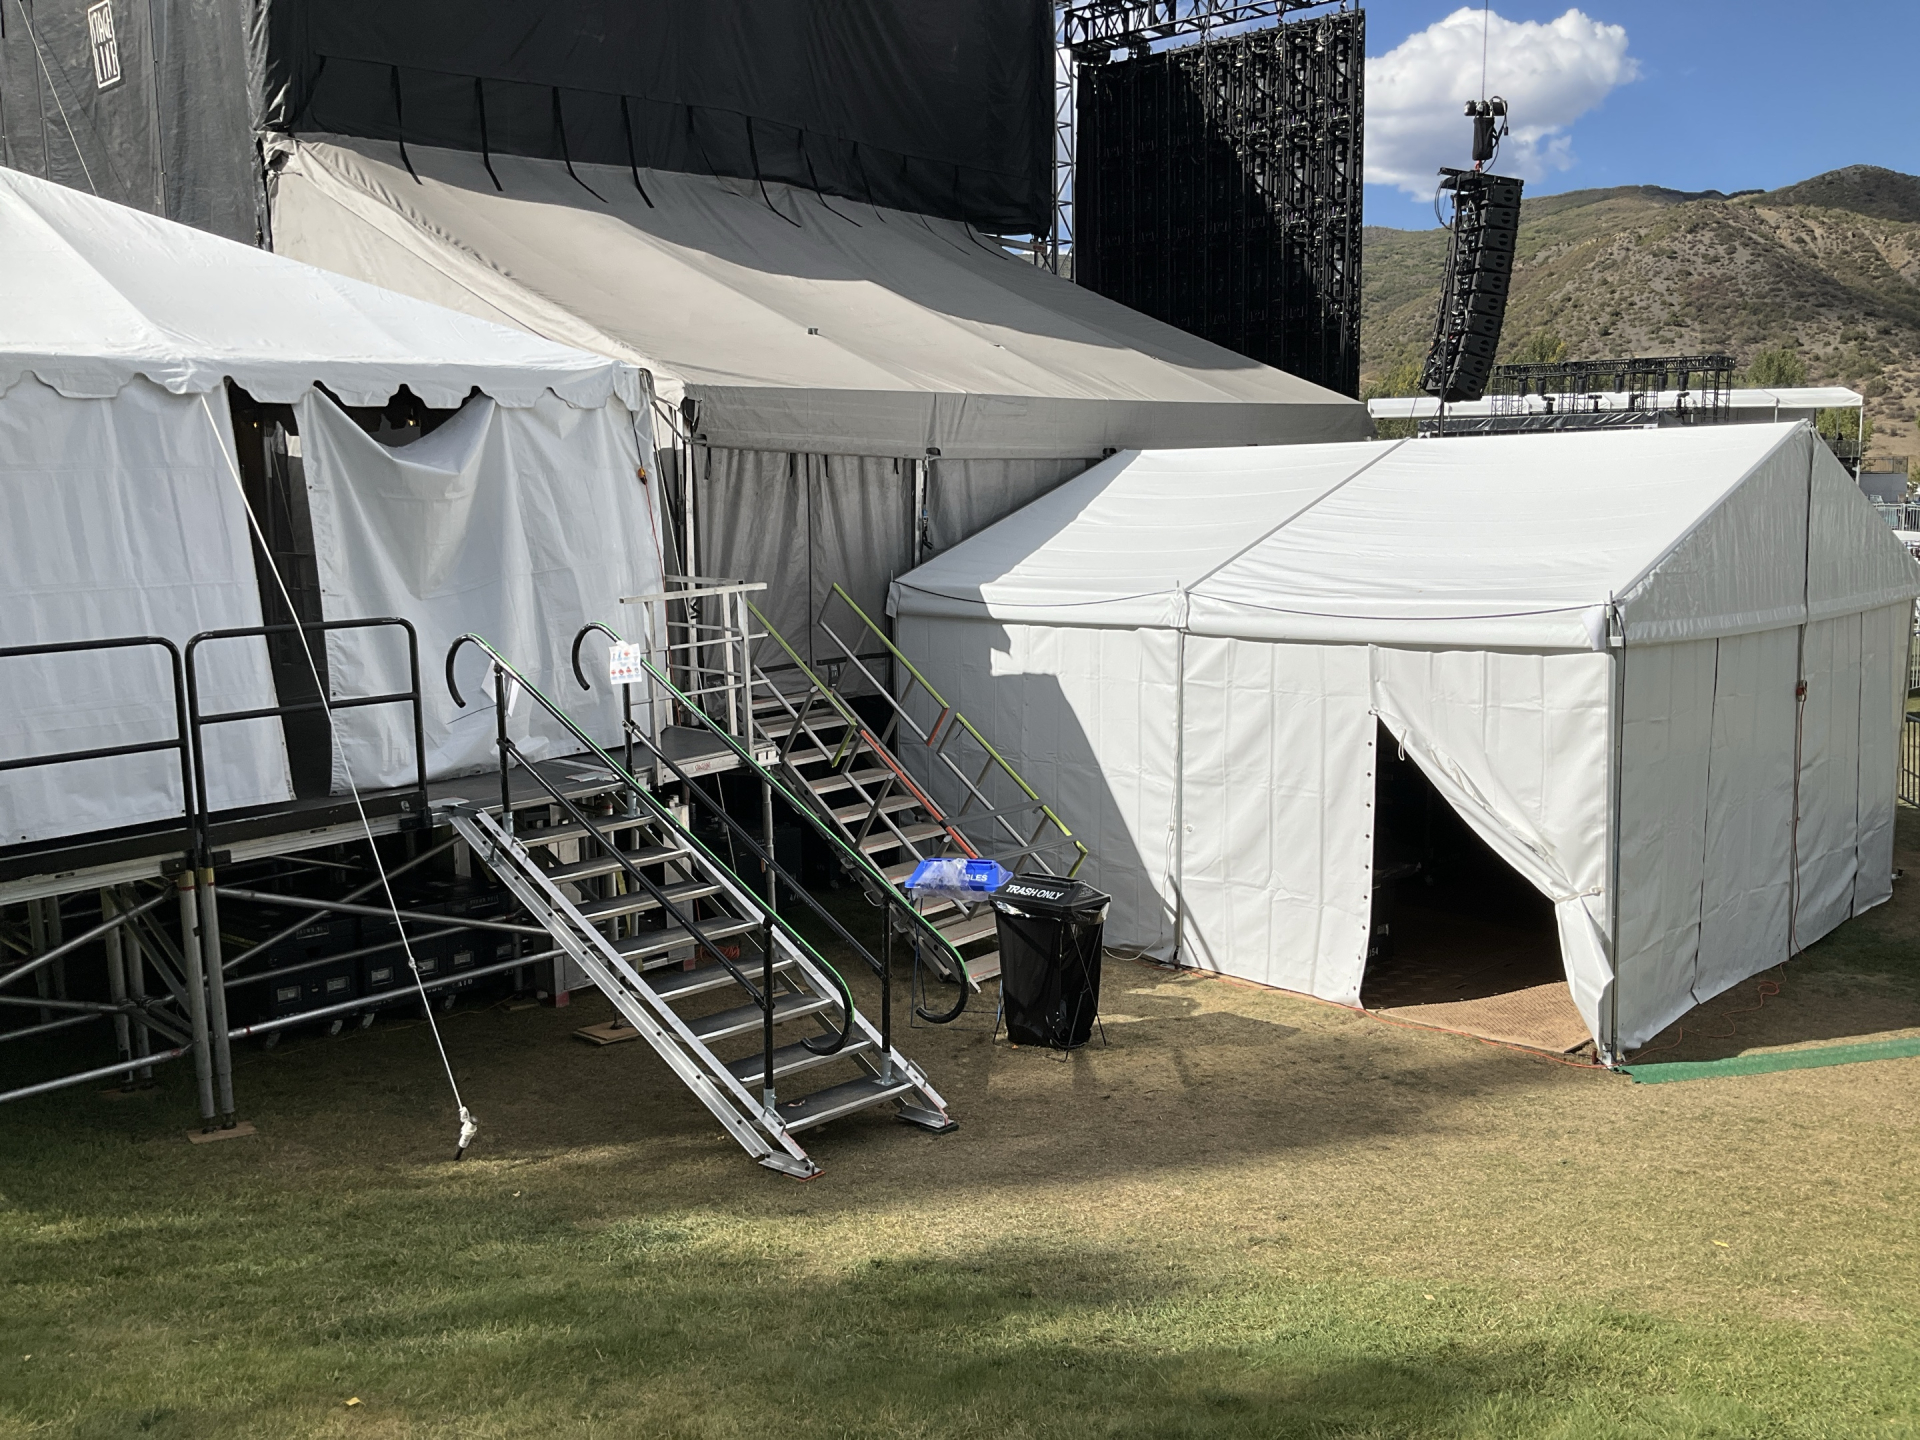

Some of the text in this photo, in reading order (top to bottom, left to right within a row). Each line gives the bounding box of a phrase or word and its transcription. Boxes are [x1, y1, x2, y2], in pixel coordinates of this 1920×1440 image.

[91, 6, 112, 44] STAGE
[95, 41, 118, 81] LINE
[1005, 884, 1039, 897] TRASH
[1036, 889, 1065, 900] ONLY
